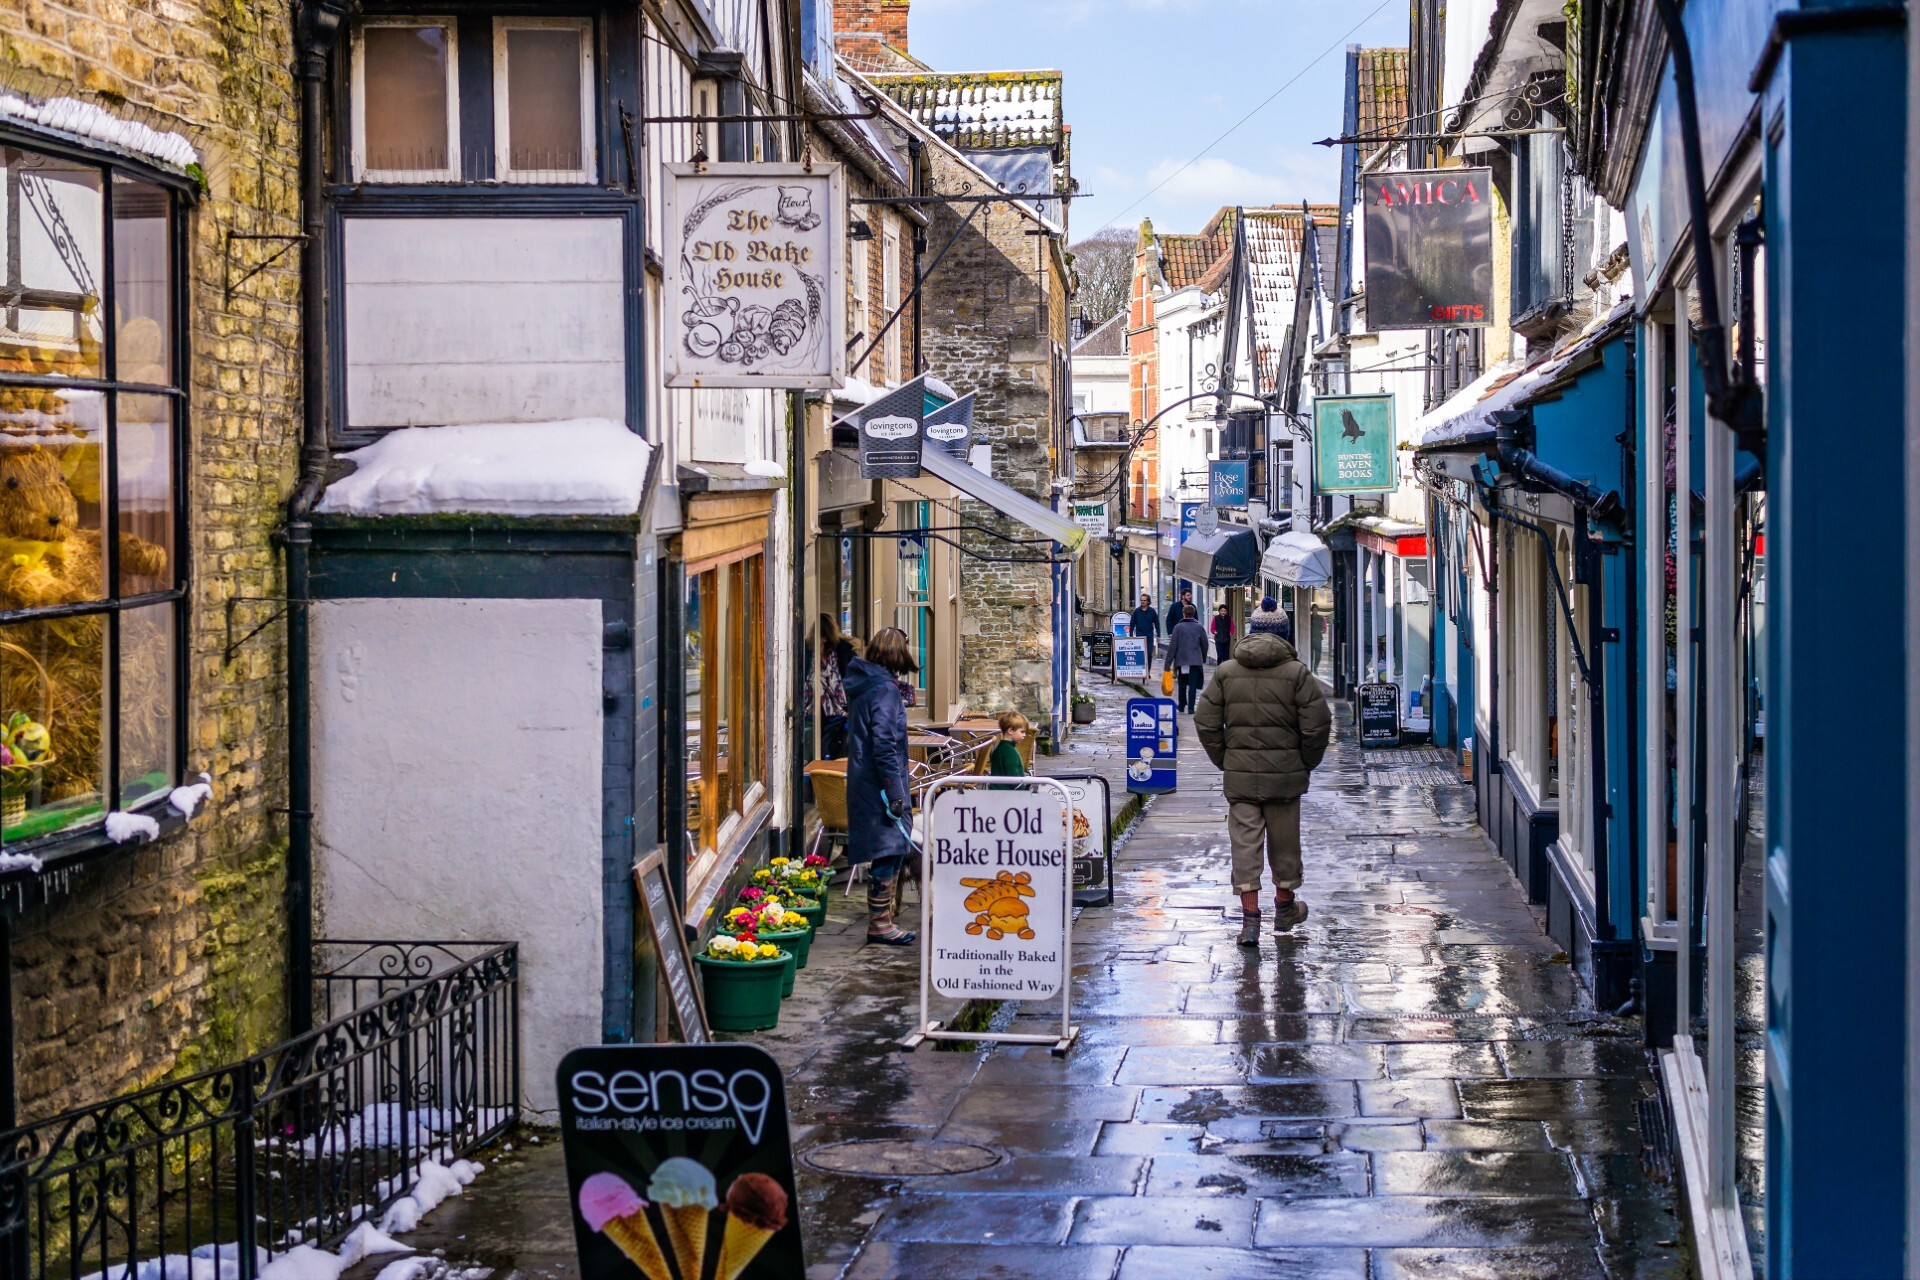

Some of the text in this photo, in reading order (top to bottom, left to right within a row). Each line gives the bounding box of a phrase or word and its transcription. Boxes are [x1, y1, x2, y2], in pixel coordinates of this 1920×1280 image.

[1374, 180, 1481, 207] AMICA
[781, 196, 809, 208] Flour
[727, 210, 771, 235] The
[692, 241, 811, 266] Old Bake
[713, 267, 784, 292] House
[1431, 304, 1484, 320] GIFTS
[870, 421, 913, 431] lovingtons
[930, 427, 964, 435] lovingtons
[1338, 460, 1372, 469] RAVEN
[1213, 471, 1239, 482] Rose
[1219, 474, 1233, 489] &
[1338, 469, 1373, 479] BOOKS
[1214, 485, 1244, 498] Lyons
[954, 806, 1043, 834] The Old
[936, 837, 1062, 867] Bake House
[937, 948, 1056, 963] Traditionally Baked
[979, 964, 1013, 976] in the
[937, 977, 1055, 994] Old Fashioned Way
[575, 1115, 736, 1133] italian-style ice cream
